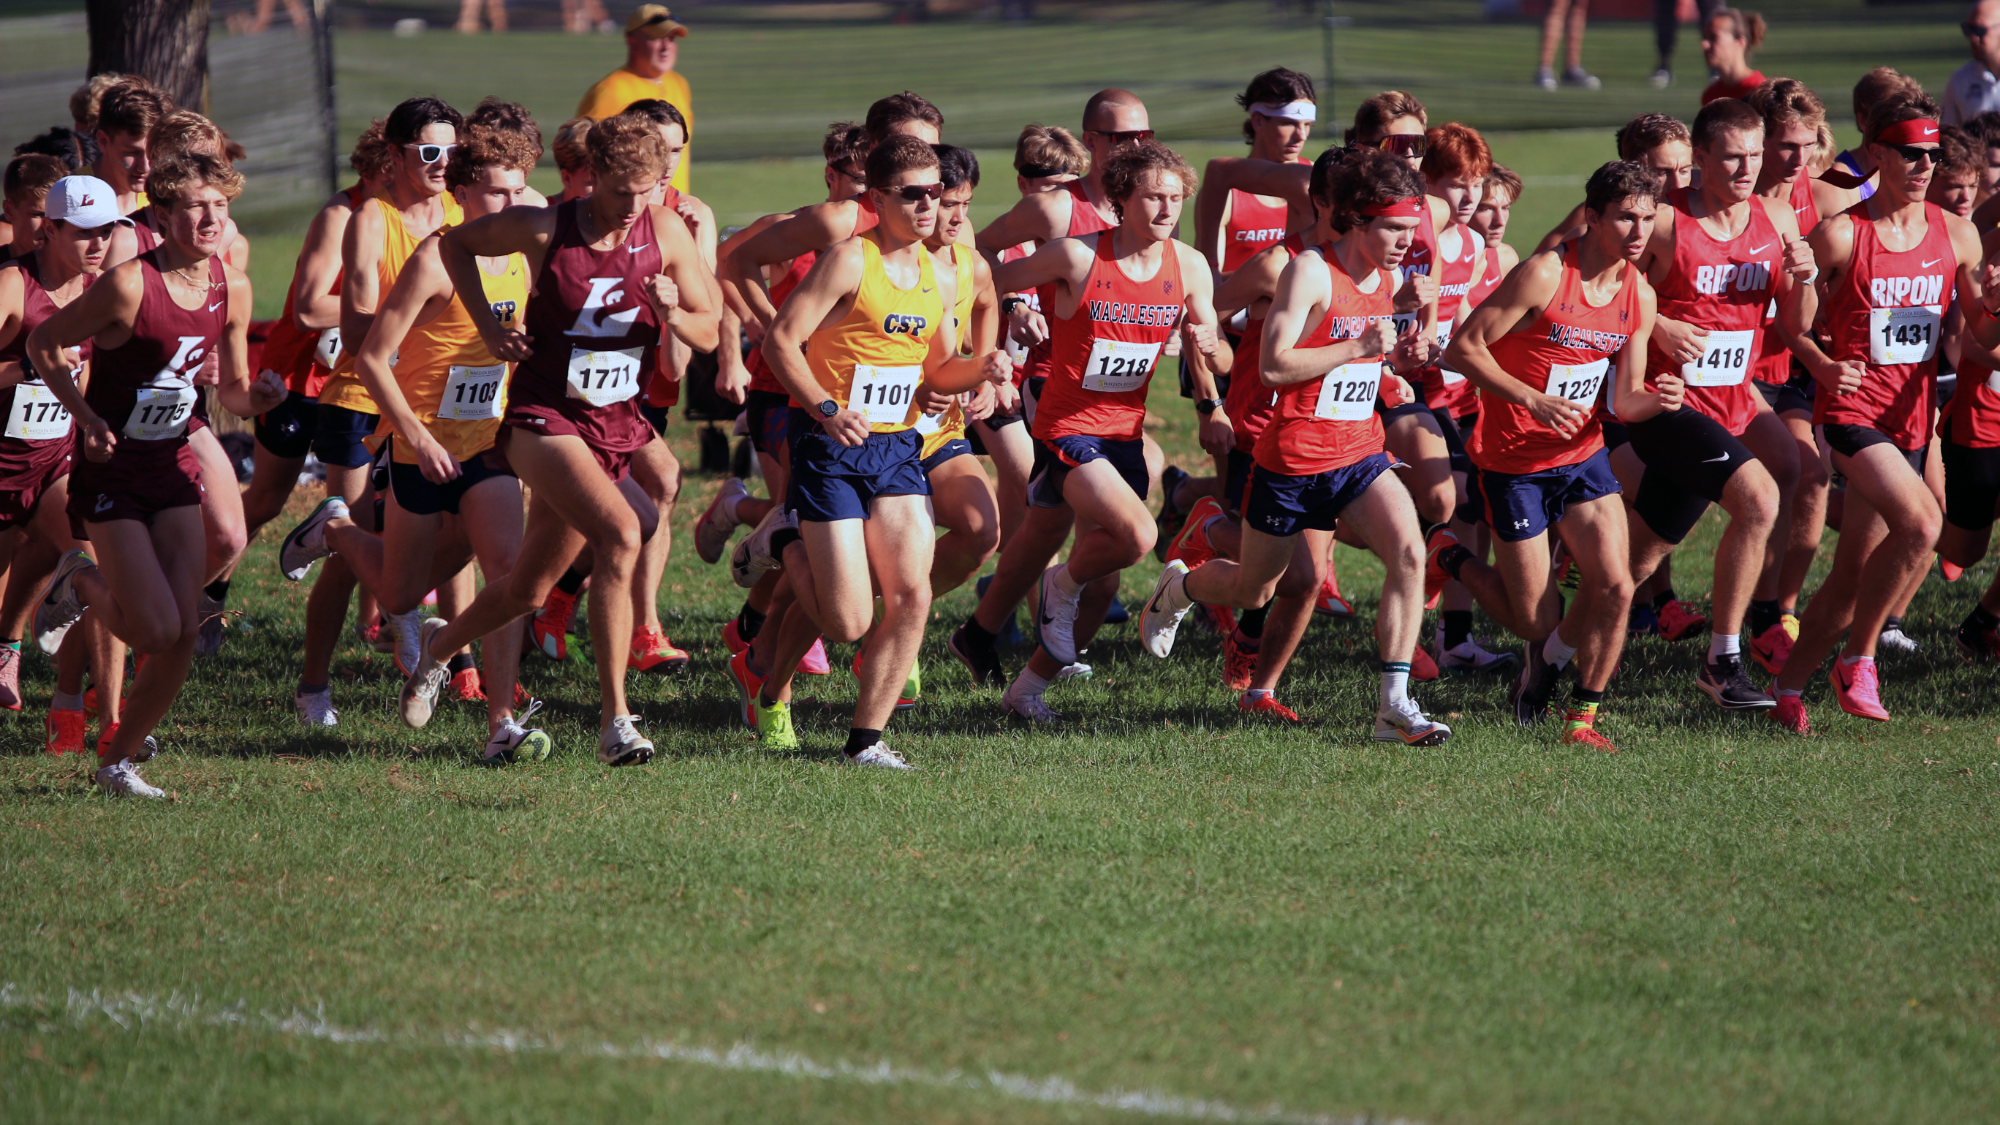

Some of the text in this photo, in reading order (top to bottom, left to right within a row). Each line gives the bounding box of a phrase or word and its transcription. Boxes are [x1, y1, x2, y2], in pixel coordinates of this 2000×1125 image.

[1697, 261, 1771, 294] RIPON
[1872, 275, 1943, 307] RIPON
[489, 300, 516, 322] SP
[884, 313, 926, 336] CSP
[1882, 323, 1932, 347] 1431
[1100, 356, 1149, 377] 1218
[1697, 348, 1745, 369] 1418
[580, 364, 630, 389] 1771
[1558, 376, 1600, 400] 1223
[455, 381, 498, 404] 1103
[863, 383, 911, 405] 1101
[1333, 381, 1375, 402] 1220
[140, 403, 188, 425] 1775
